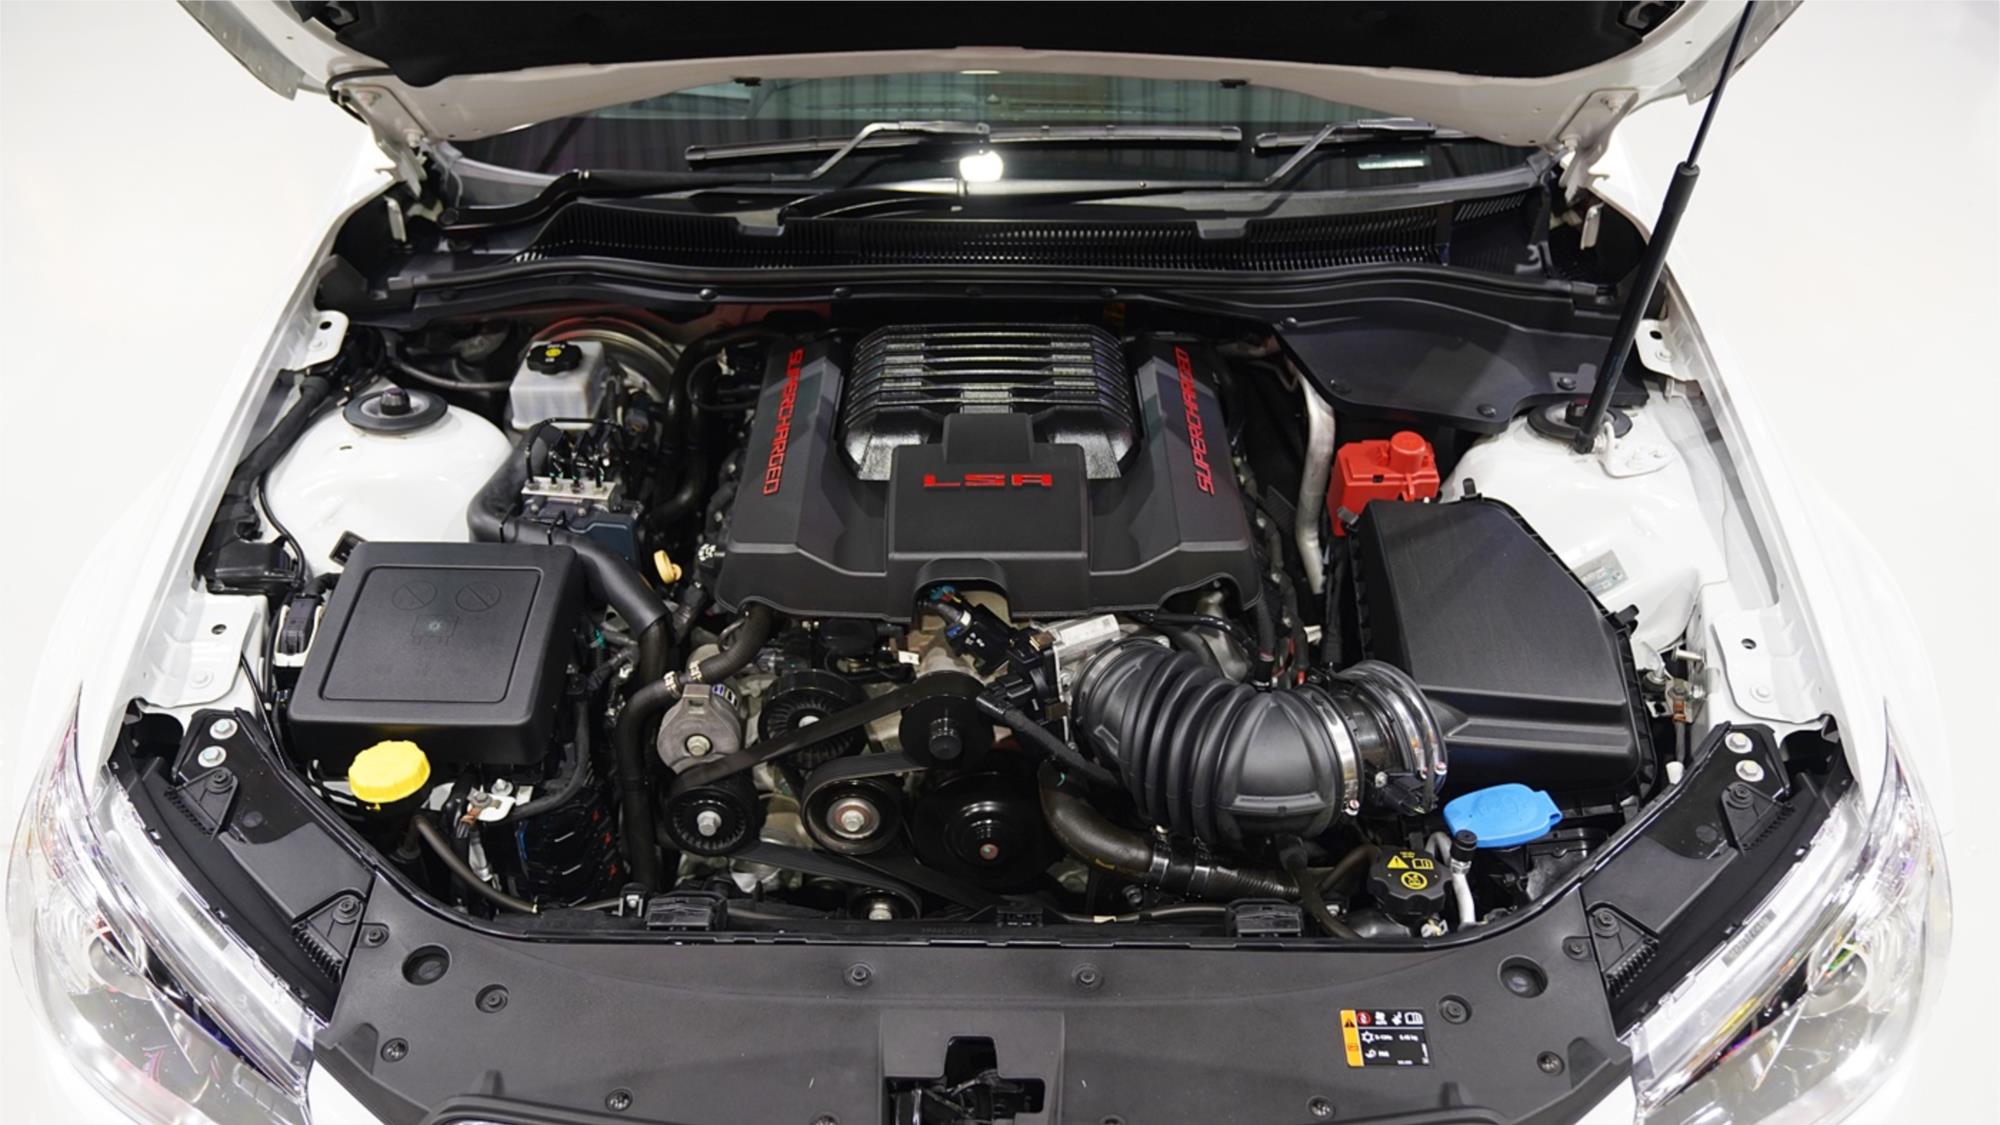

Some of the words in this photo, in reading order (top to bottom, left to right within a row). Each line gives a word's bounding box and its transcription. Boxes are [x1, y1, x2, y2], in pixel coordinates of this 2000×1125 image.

[763, 348, 805, 496] SUPERCHARGED
[922, 473, 1054, 488] LSA
[1174, 347, 1215, 495] SUPERCHARGED
